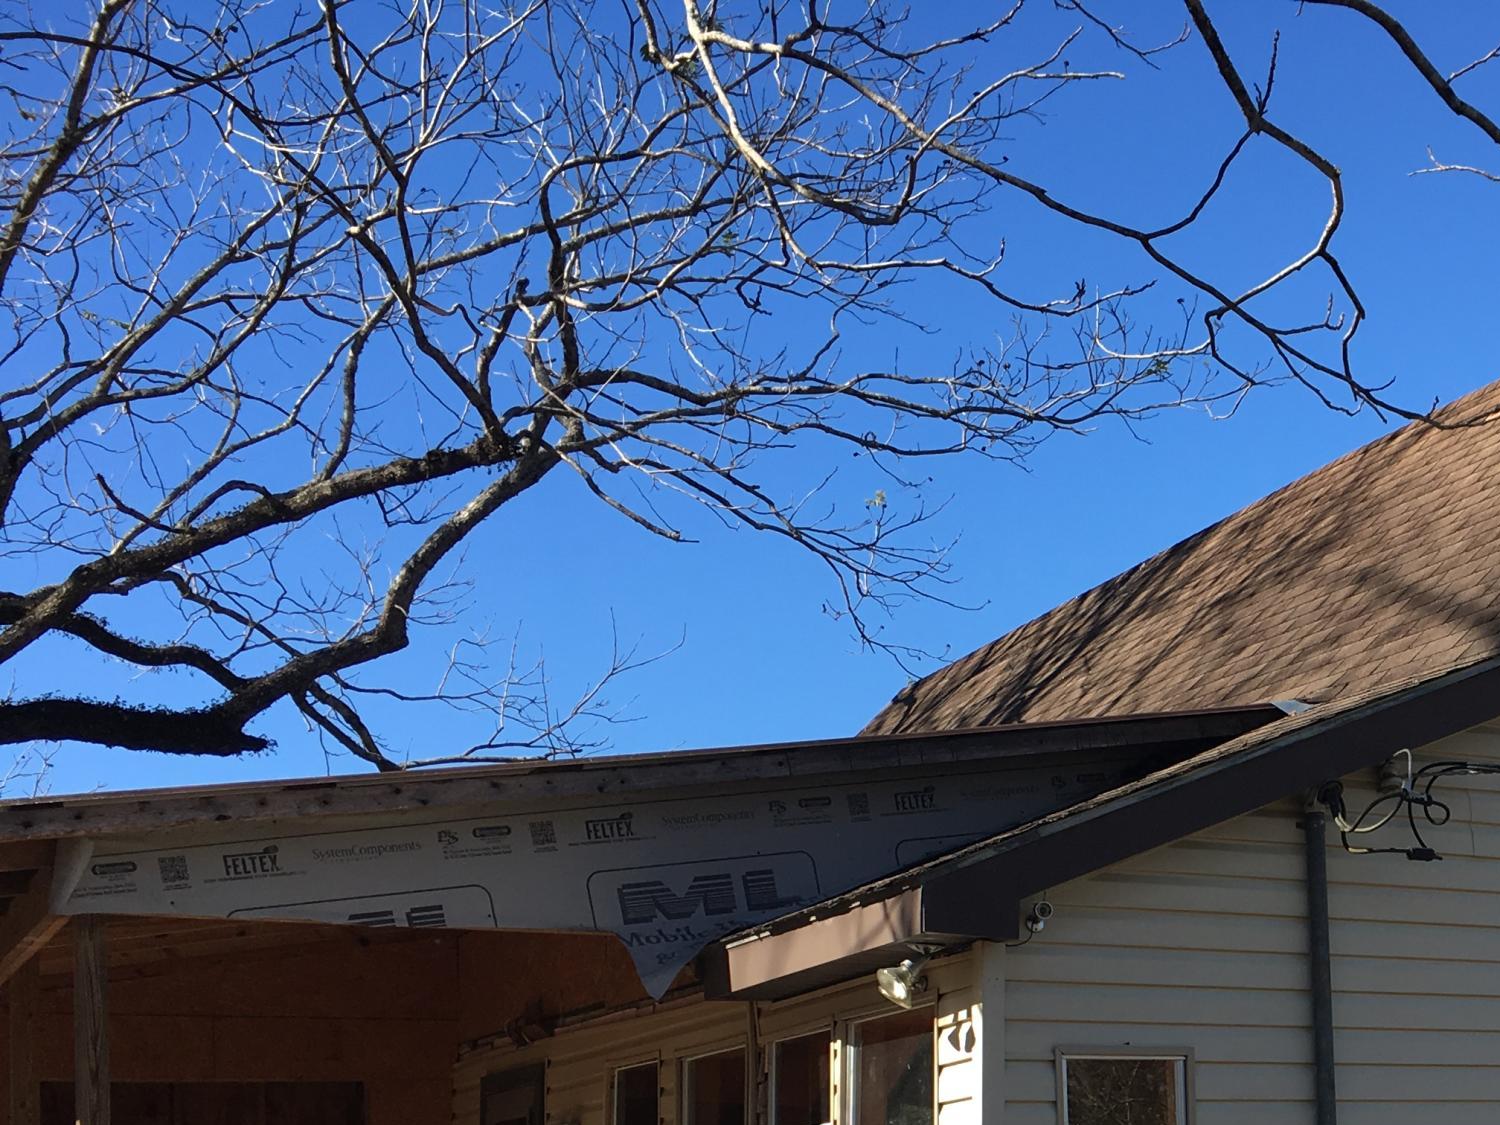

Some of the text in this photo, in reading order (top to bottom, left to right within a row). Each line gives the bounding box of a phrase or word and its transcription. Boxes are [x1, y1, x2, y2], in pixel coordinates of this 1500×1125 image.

[894, 790, 936, 811] FELTEX
[585, 819, 635, 841] FELTEX
[223, 851, 281, 877] FELTEX
